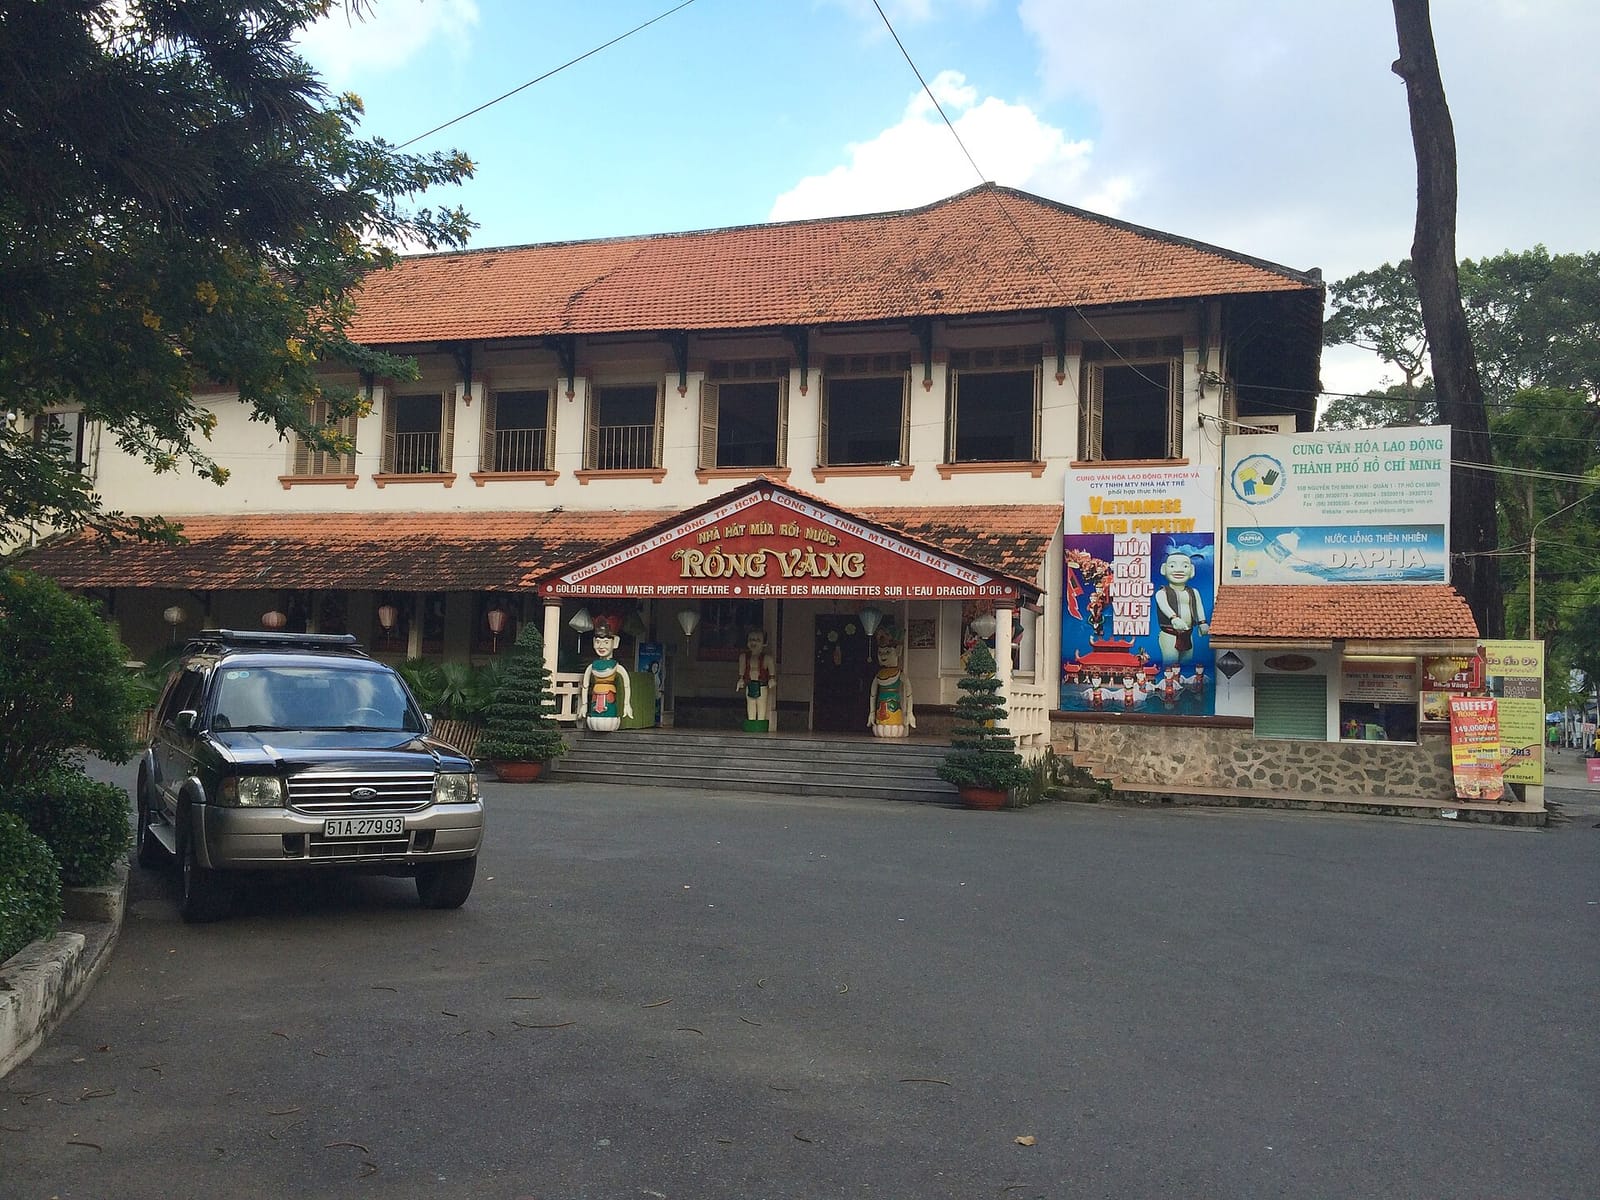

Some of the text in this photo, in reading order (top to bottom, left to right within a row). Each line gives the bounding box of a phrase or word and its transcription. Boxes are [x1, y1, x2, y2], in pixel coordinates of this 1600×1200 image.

[1293, 437, 1443, 455] CUNG VĂN HÓA LAO ĐỘNG
[1292, 455, 1441, 474] THÀNH PHỐ HỒ CHÍ MINH
[698, 520, 836, 546] NHÀ HÁT MÚA RỐI NƯỚC
[812, 510, 826, 520] TY
[834, 518, 865, 536] TNHH
[868, 533, 895, 548] MTV
[926, 555, 950, 570] HÁT
[1324, 533, 1347, 543] NƯỚC
[1376, 532, 1399, 543] THIÊN
[1402, 532, 1428, 542] NHIÊN
[1113, 538, 1150, 556] MÚA
[571, 567, 598, 582] CUNG
[626, 543, 648, 558] HÓA
[652, 533, 673, 547] LAO
[762, 546, 865, 578] VÀNG
[1326, 548, 1427, 569] DAPHA
[556, 584, 729, 595] GOLDEN DRAGON WATER PUPPET THEATRE
[748, 583, 1002, 596] THÉÂTRE DES MARIONNETTES SUR L'EAU DRAGON D'OR
[1109, 580, 1154, 597] NƯỚC
[1112, 600, 1151, 619] VIỆT
[1113, 621, 1150, 636] NAM
[1451, 701, 1494, 712] BUFFET
[327, 818, 402, 836] 51A-279.93
